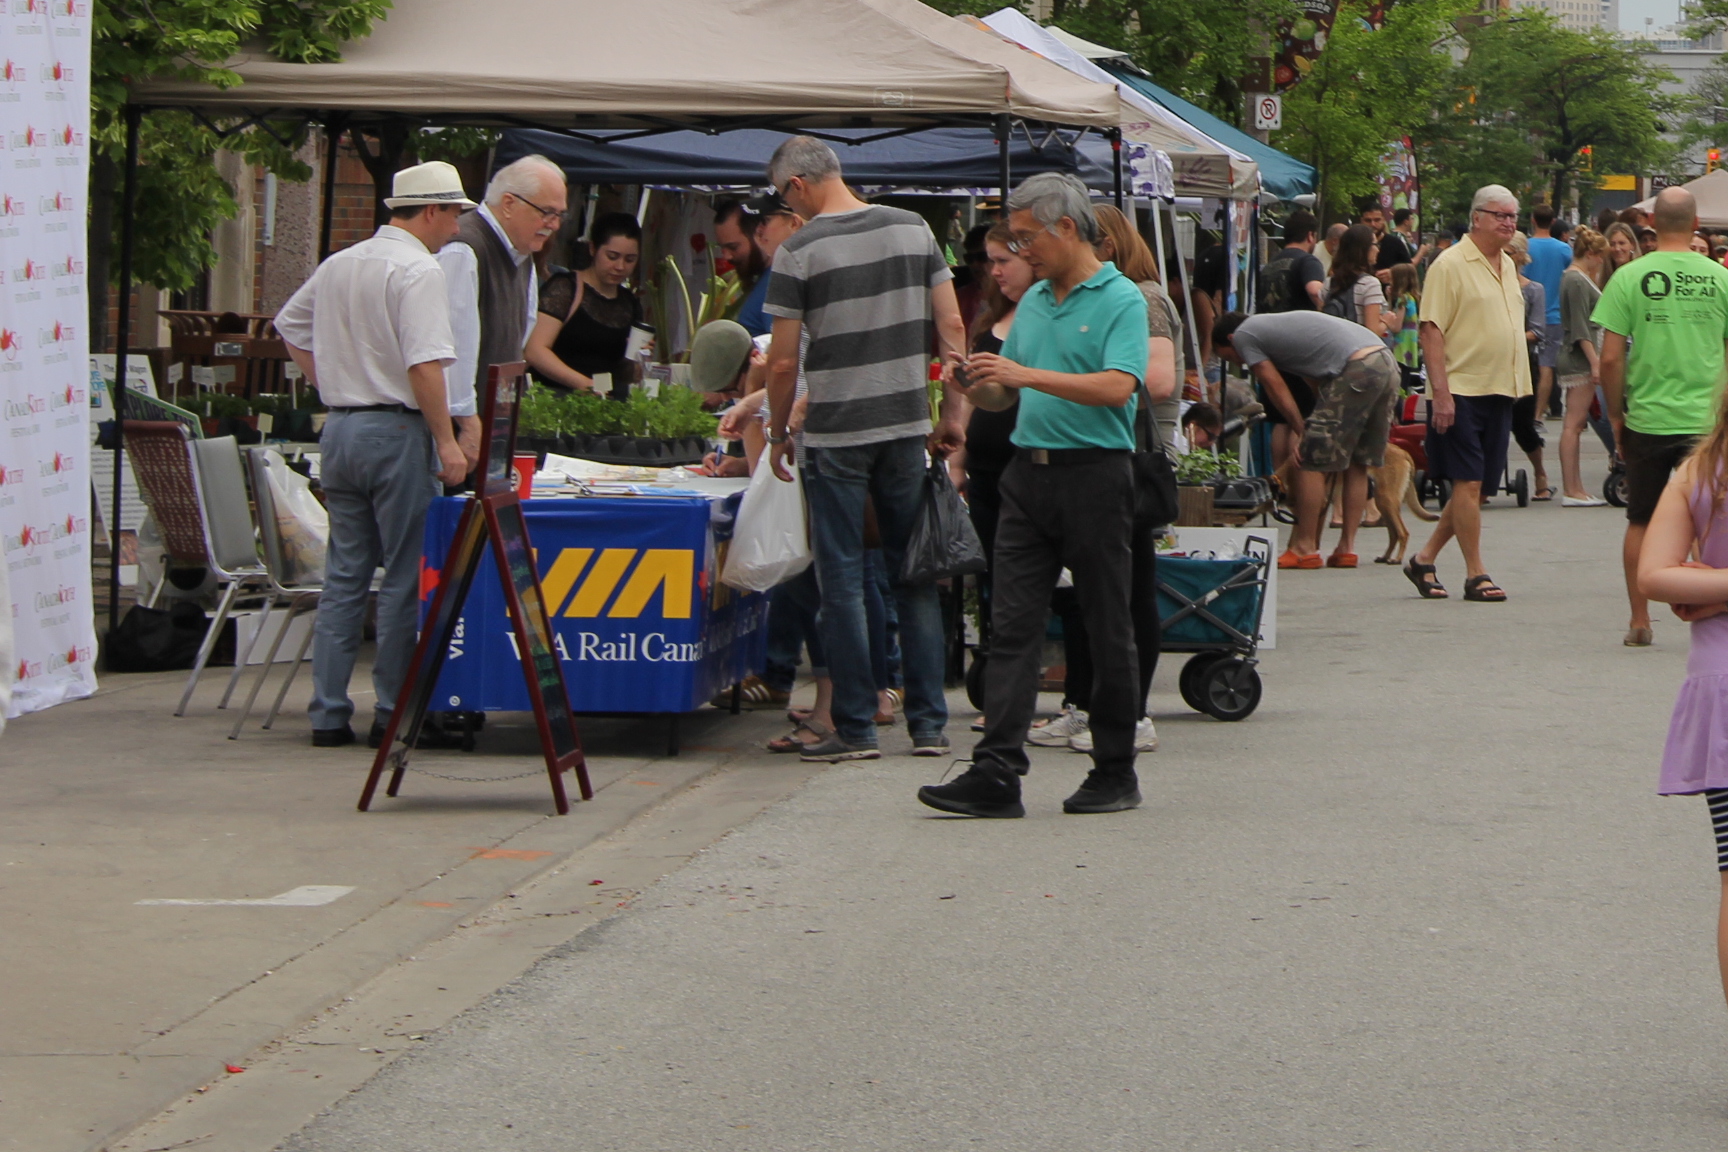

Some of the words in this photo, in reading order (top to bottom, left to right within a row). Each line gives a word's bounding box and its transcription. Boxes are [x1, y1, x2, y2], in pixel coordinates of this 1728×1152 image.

[1675, 271, 1716, 286] Sport
[1675, 286, 1696, 296] For
[1699, 286, 1716, 297] All
[579, 632, 637, 662] Rail
